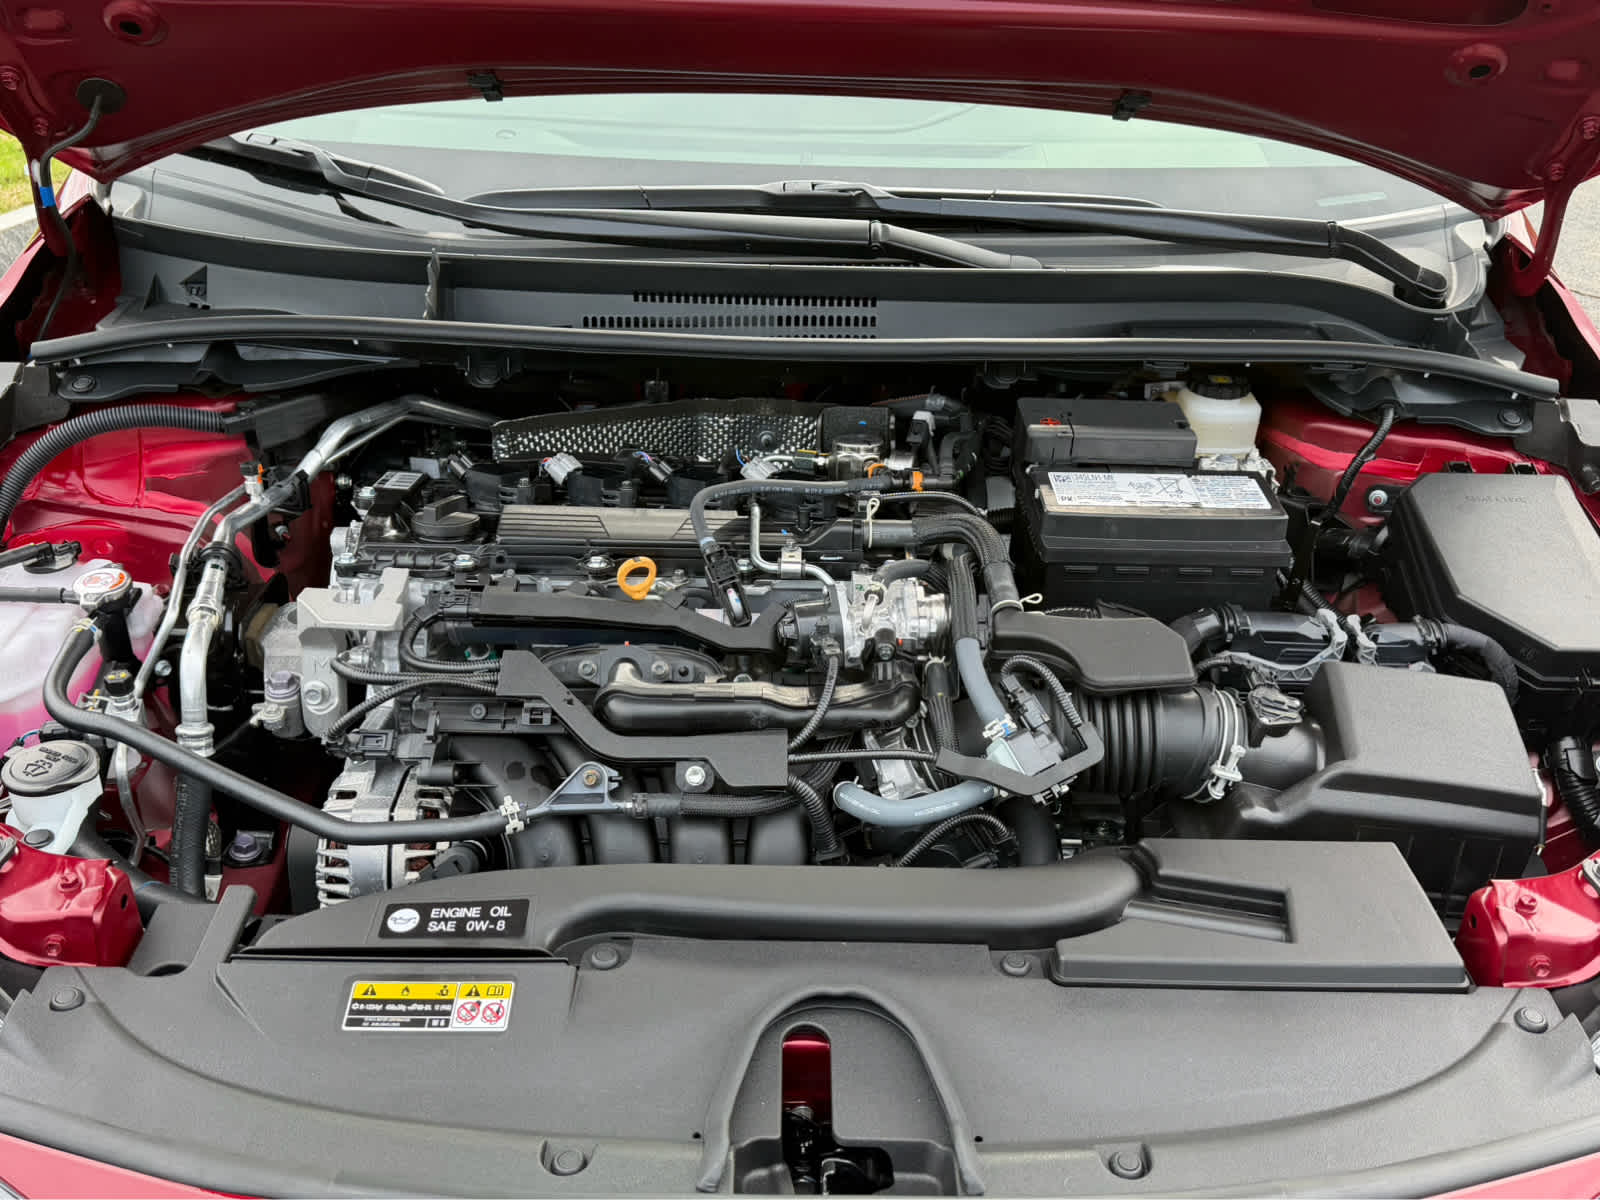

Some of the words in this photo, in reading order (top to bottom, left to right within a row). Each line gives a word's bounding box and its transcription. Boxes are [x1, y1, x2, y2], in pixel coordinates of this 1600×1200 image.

[430, 906, 482, 919] ENGINE
[489, 905, 512, 917] OIL
[427, 920, 457, 932] SAE
[465, 919, 506, 932] 0W-8
